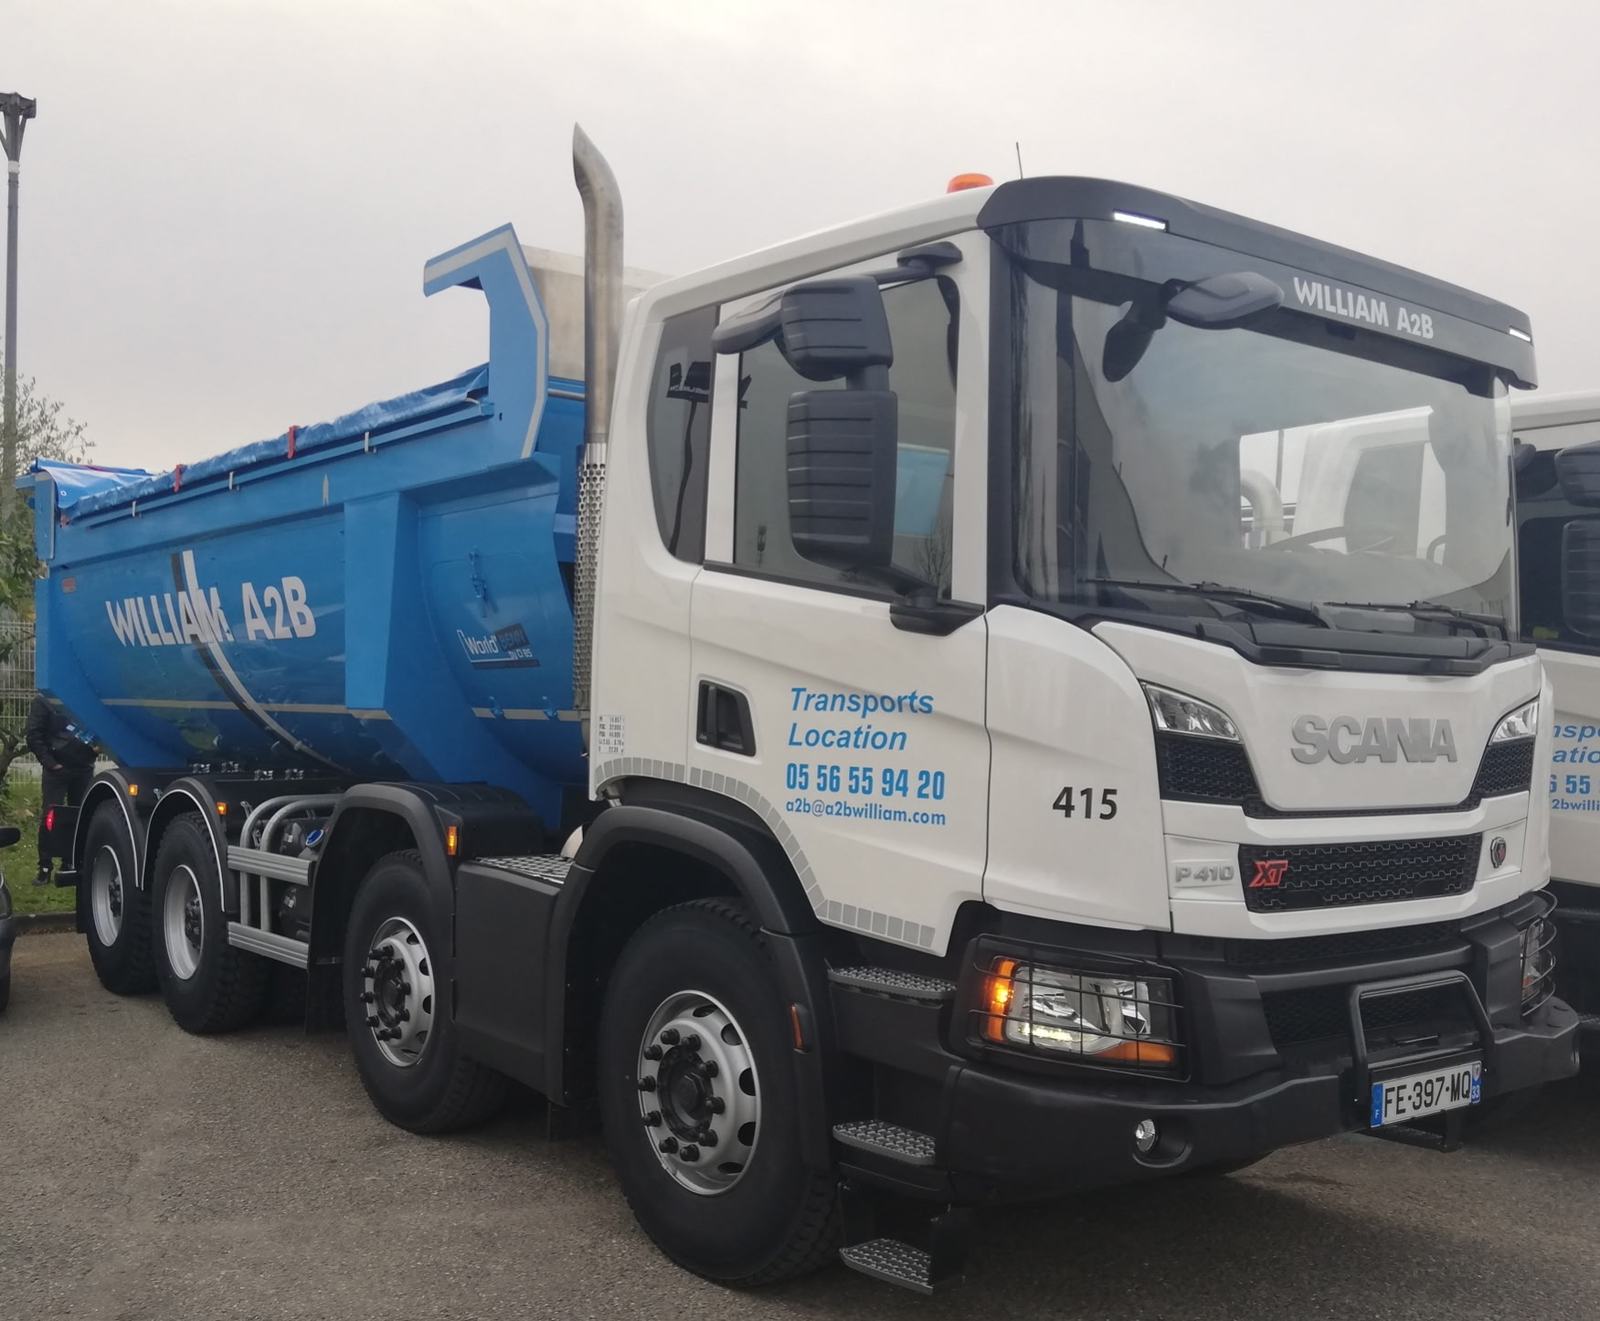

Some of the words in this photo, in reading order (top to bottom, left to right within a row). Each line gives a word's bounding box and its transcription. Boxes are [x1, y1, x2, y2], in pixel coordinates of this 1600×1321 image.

[1294, 276, 1390, 327] WILLIAM
[1397, 307, 1434, 339] A2B
[105, 586, 235, 646] WILLIAM
[242, 576, 317, 641] A2B
[791, 687, 935, 719] Transports
[788, 722, 908, 751] Location
[1290, 714, 1458, 765] SCANIA
[786, 763, 809, 790] 05
[816, 765, 840, 792] 56
[848, 766, 873, 795] 55
[881, 768, 909, 797] 94
[917, 770, 945, 800] 20
[1565, 774, 1591, 794] 55
[786, 798, 947, 826] a2b@a2bwilliam.com
[1052, 786, 1118, 821] 415
[1247, 859, 1289, 888] XT
